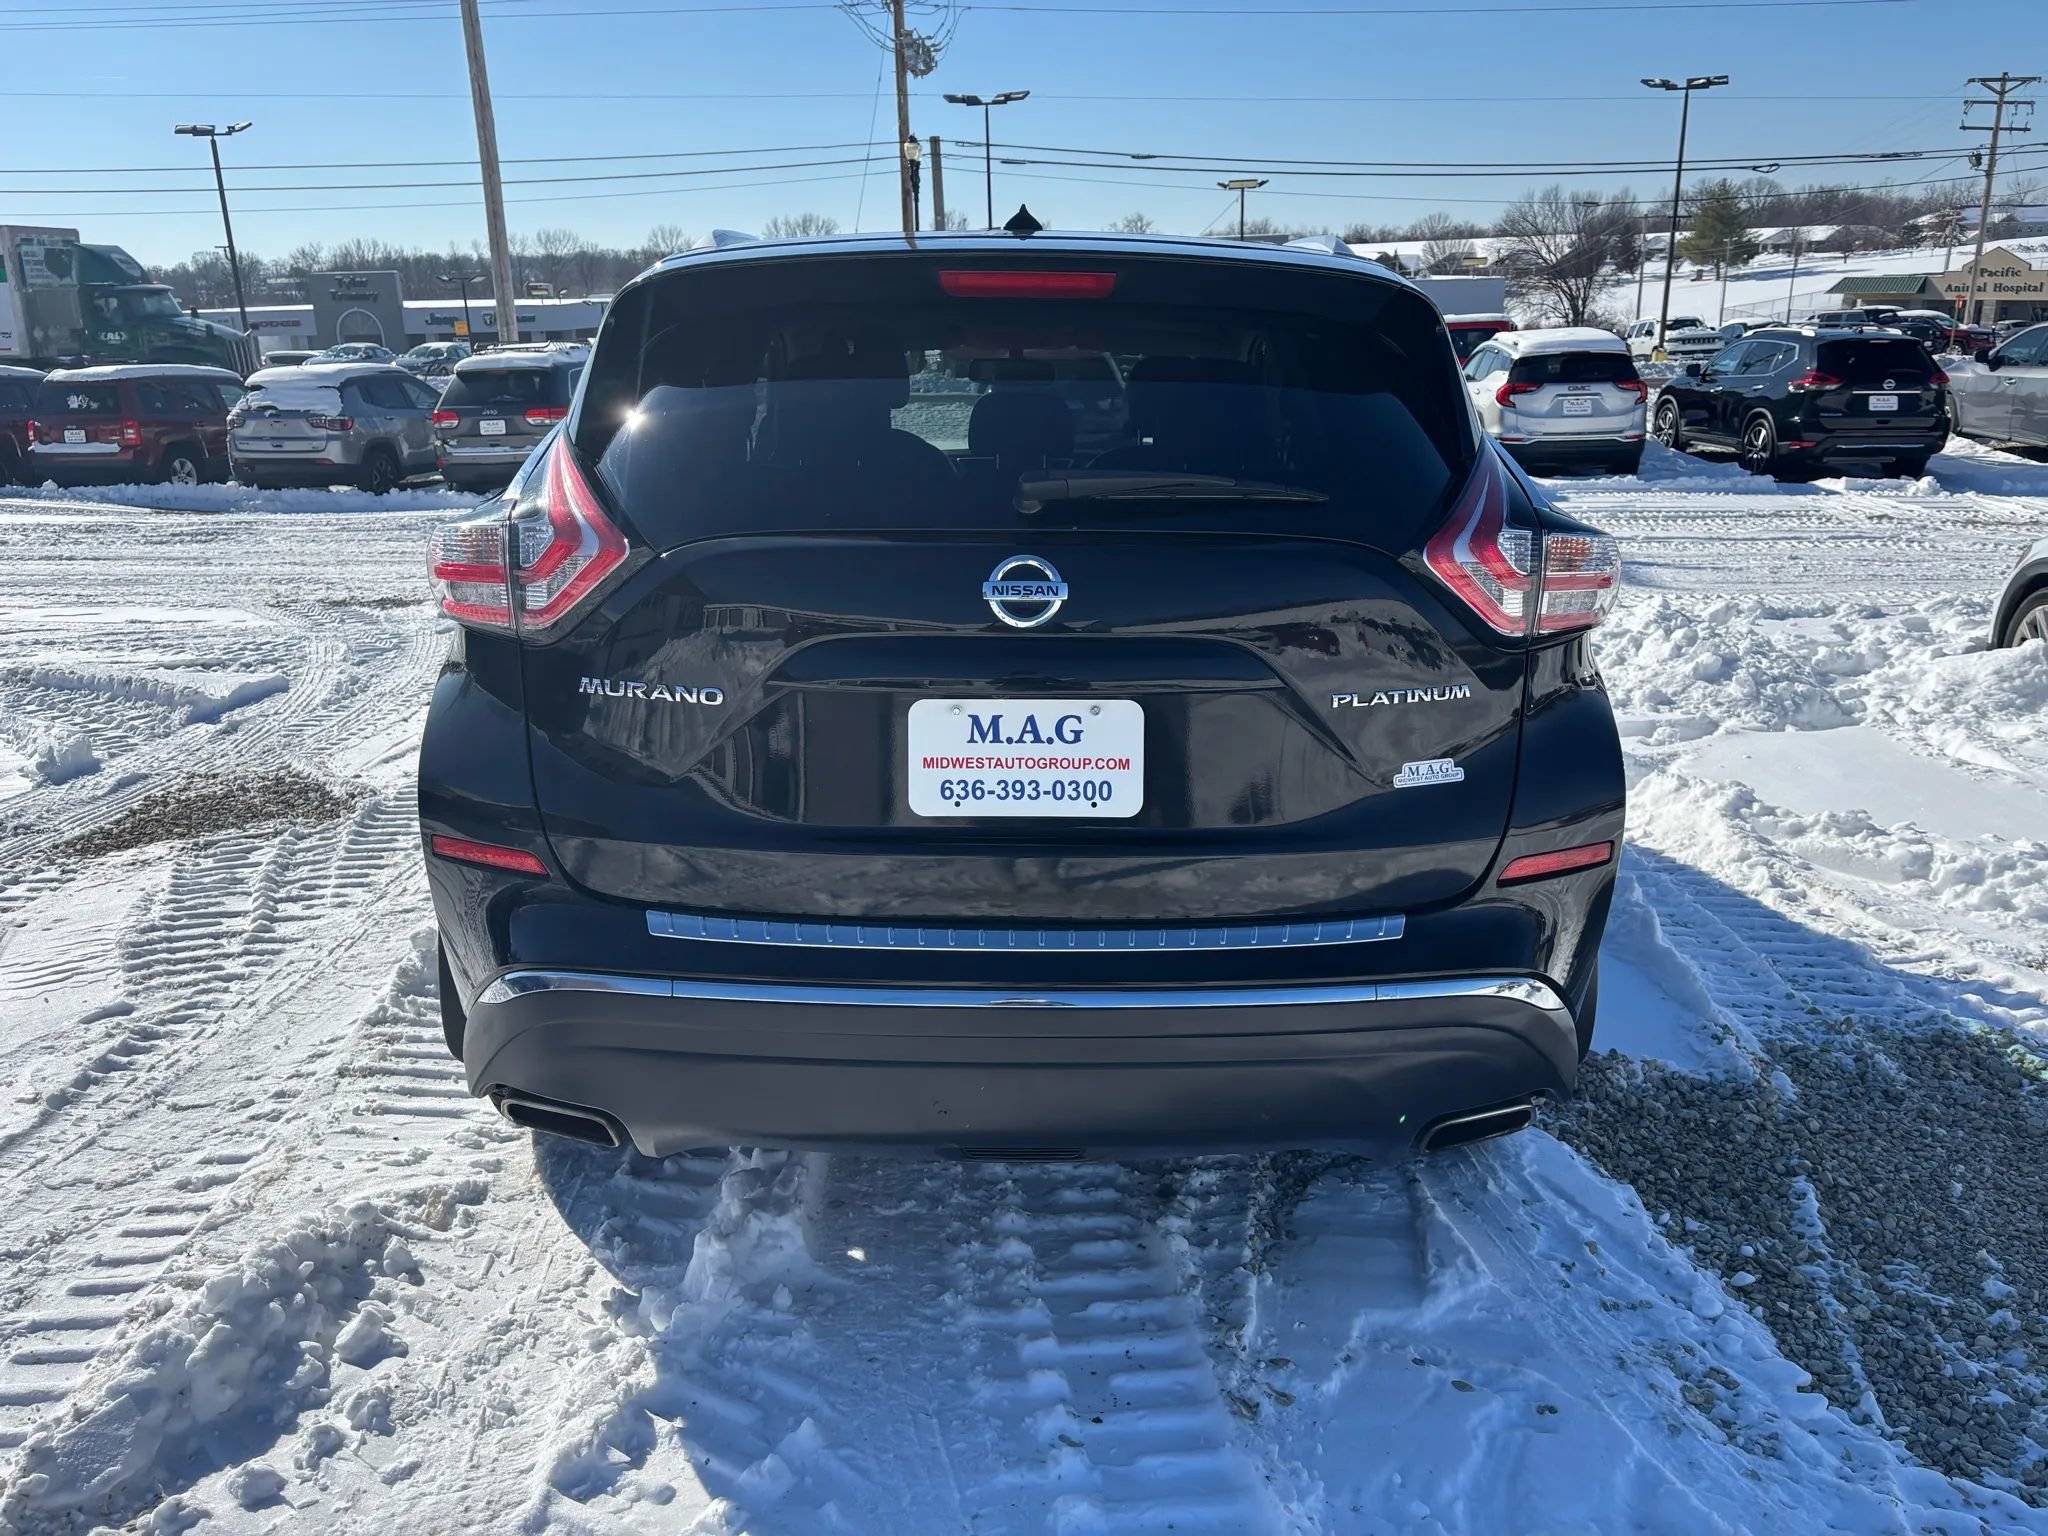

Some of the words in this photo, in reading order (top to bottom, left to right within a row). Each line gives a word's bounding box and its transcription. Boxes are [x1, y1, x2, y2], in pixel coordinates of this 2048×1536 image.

[1980, 267, 2022, 277] Pacific
[1945, 282, 1987, 293] Anial
[1993, 282, 2043, 294] Hospital
[991, 585, 1059, 597] NISSAN
[578, 676, 724, 706] MURANO
[1331, 684, 1471, 709] PLATINUM
[966, 713, 1084, 745] M.A.G
[922, 756, 1131, 771] MIDWESTAUTOGROUP.COM
[1407, 762, 1449, 778] M.A.G
[1397, 776, 1423, 784] MIDWEST
[1441, 771, 1460, 779] GROUP
[939, 779, 1113, 802] 636-393-0300
